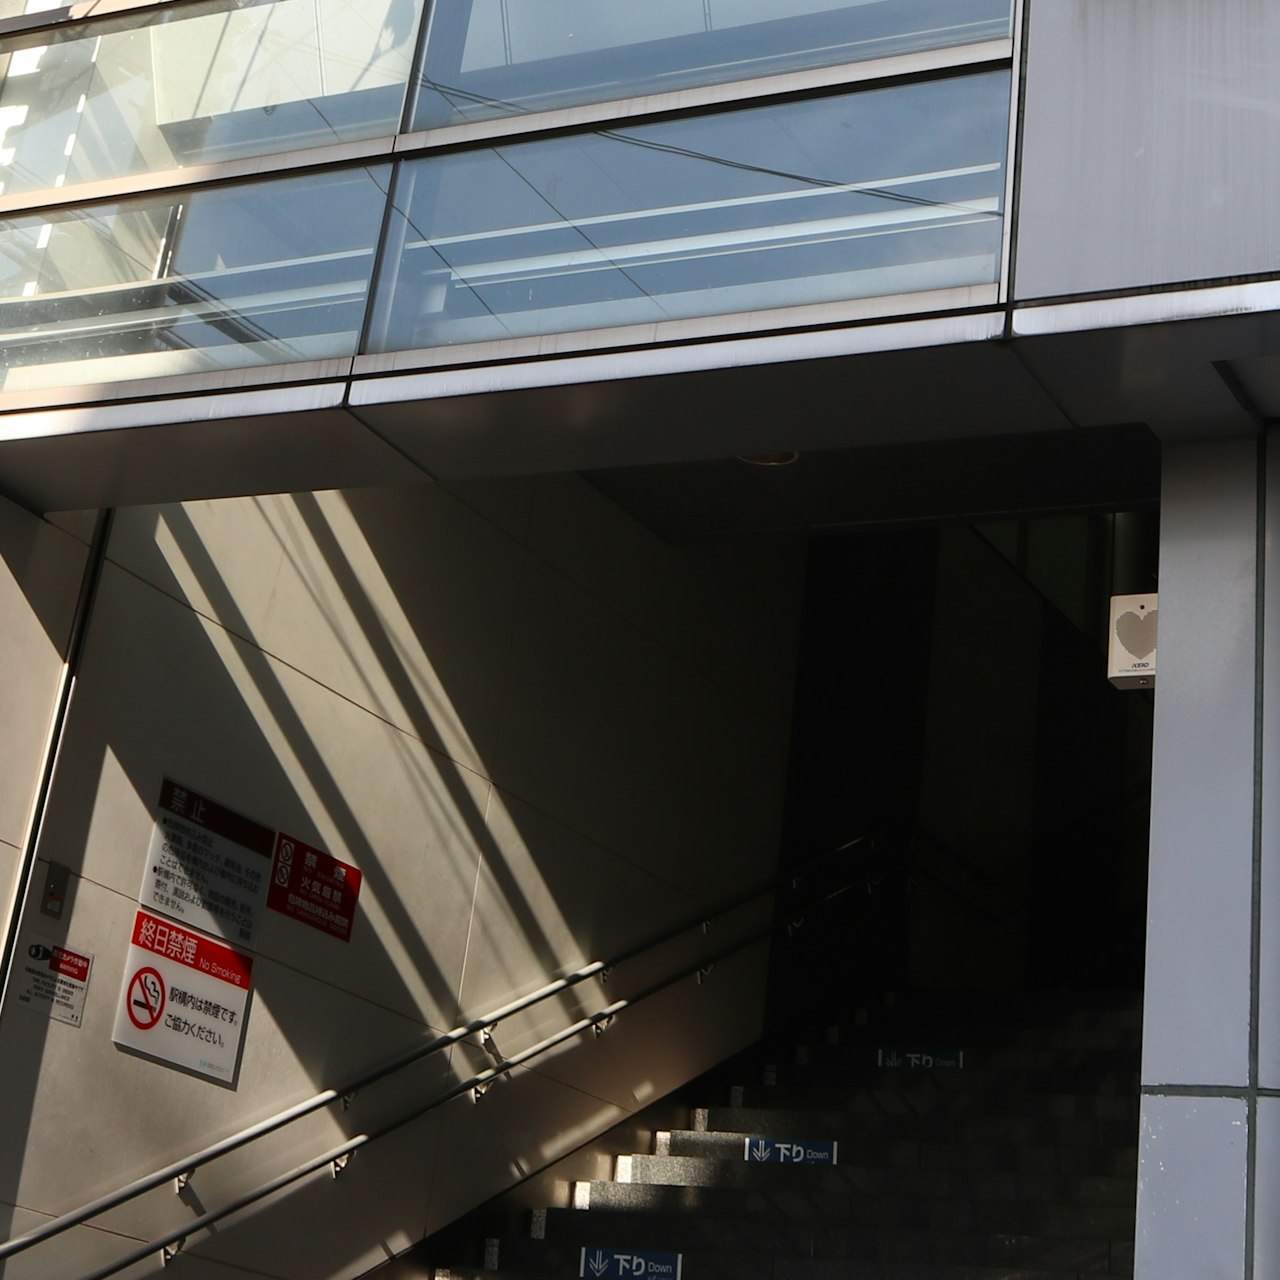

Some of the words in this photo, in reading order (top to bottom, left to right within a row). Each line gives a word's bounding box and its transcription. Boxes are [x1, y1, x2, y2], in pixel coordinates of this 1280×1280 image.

[170, 787, 207, 824] 禁止
[139, 917, 199, 965] 終日禁煙
[199, 957, 210, 971] No
[211, 961, 242, 985] Smoking
[169, 987, 239, 1027] 駅構内は禁煙です。
[164, 1013, 225, 1048] ご協力ください。
[906, 1053, 933, 1068] 下り
[775, 1143, 805, 1163] 下り
[806, 1149, 828, 1160] Down
[613, 1253, 646, 1277] 下り
[647, 1261, 673, 1274] Down
